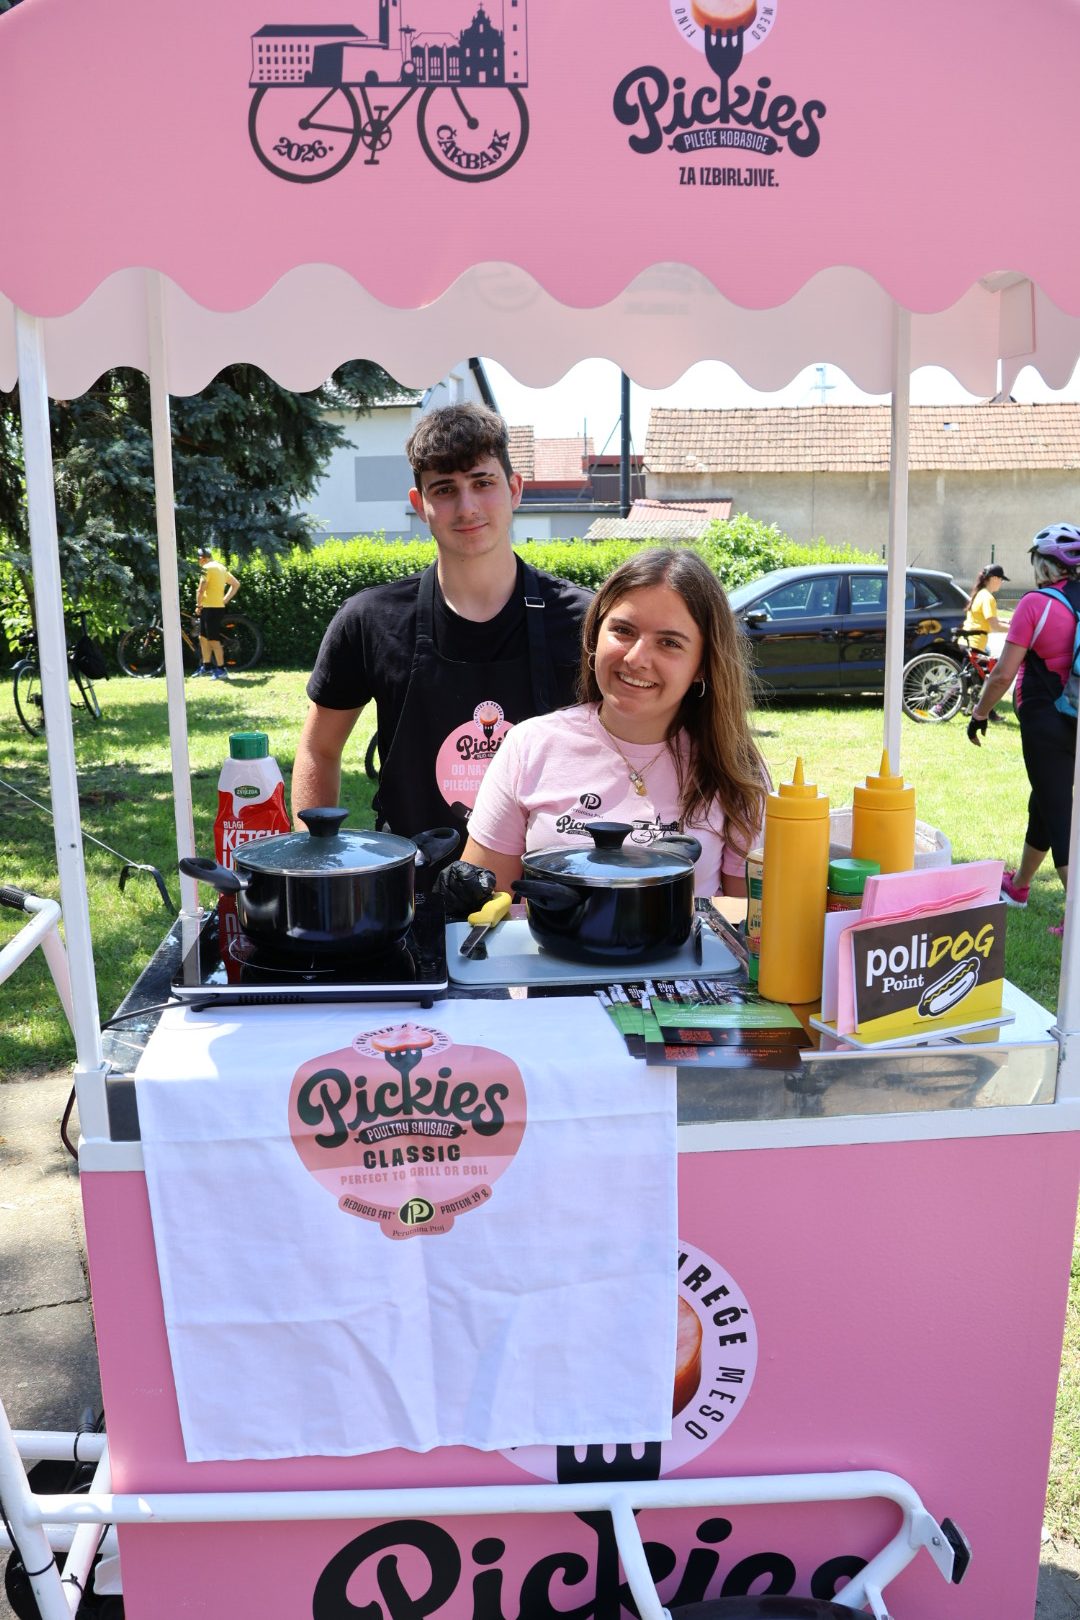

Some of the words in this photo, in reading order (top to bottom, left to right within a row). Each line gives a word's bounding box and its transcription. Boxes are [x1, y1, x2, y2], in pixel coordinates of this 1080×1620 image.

[674, 8, 696, 38] FINO
[751, 7, 774, 40] MESO
[613, 65, 827, 158] Pickies
[436, 124, 511, 170] ČAKBAJK
[683, 128, 712, 150] PILEĆE
[719, 130, 769, 152] KOBASICE
[679, 166, 696, 186] ZA
[700, 167, 780, 187] IZBIRLJIVE.
[456, 734, 506, 760] Picki
[223, 820, 244, 829] BLAGI
[882, 974, 924, 993] Point
[297, 1067, 509, 1149] Pickies
[366, 1122, 410, 1142] POULTRY
[411, 1122, 454, 1137] SAUSAGE
[363, 1144, 461, 1170] CLASSIC
[340, 1172, 388, 1186] PERFECT
[393, 1170, 406, 1182] TO
[410, 1166, 441, 1178] GRILL
[444, 1166, 460, 1176] OR
[463, 1165, 489, 1176] BOIL
[343, 1197, 376, 1217] REDUCED
[440, 1198, 472, 1215] PROTEIN
[472, 1191, 481, 1203] 19
[678, 1250, 749, 1347] REĆE
[684, 1366, 746, 1440] MESO
